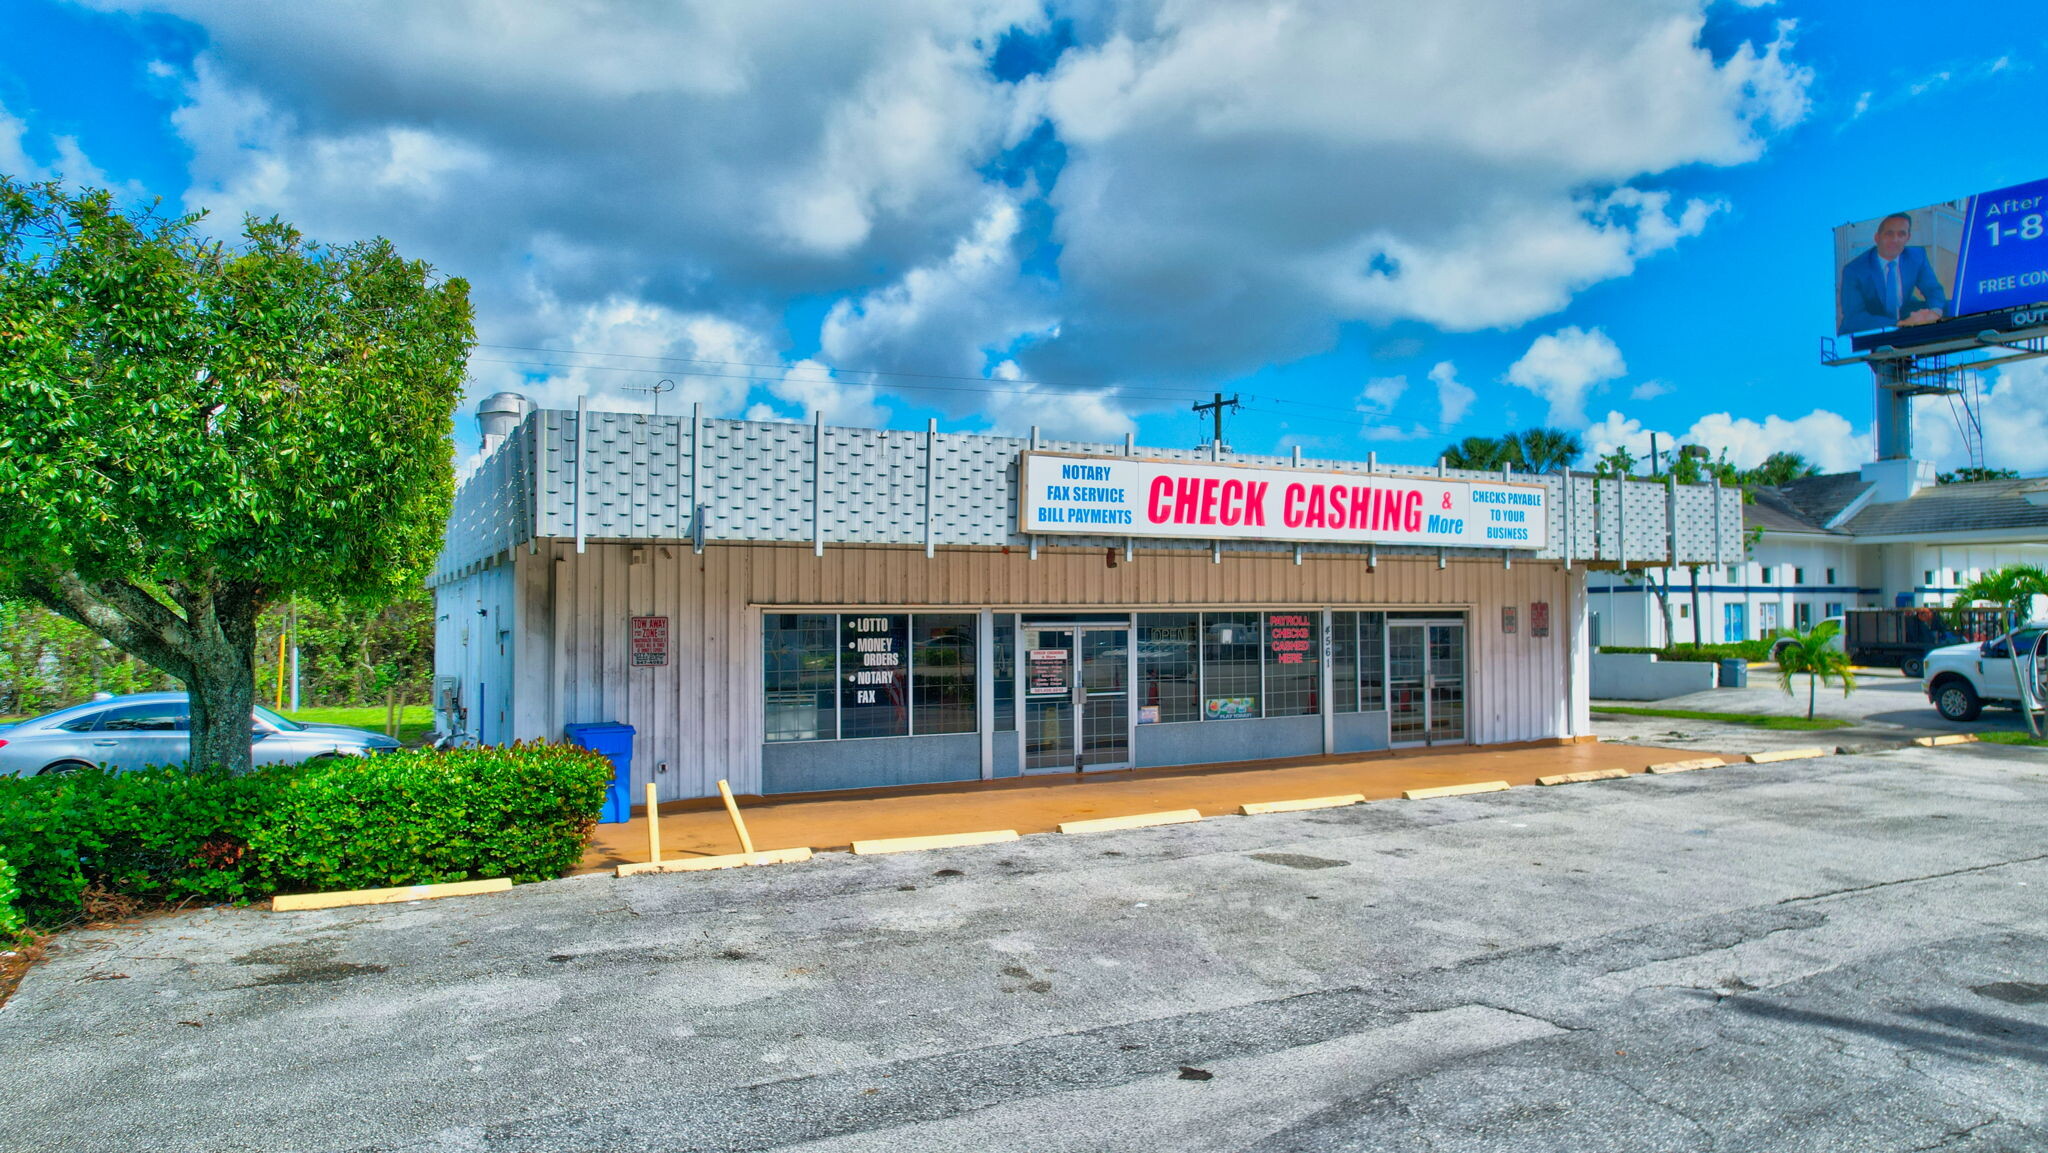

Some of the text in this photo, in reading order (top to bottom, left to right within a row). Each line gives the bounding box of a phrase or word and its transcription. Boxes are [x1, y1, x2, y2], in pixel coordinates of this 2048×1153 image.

[1986, 196, 2042, 218] After
[1979, 275, 2016, 294] FREE
[1062, 465, 1111, 481] NOTARY
[1047, 485, 1125, 503] FAX SERVICE
[1441, 491, 1453, 510] &
[1472, 490, 1541, 506] CHECKS PAYABLE
[1147, 475, 1423, 533] CHECK CASHING
[1038, 507, 1132, 525] BILL PAYMENTS
[1490, 509, 1525, 522] TO YOUR
[1427, 514, 1463, 535] More
[1487, 527, 1528, 540] BUSINESS
[634, 619, 666, 629] TOW AWAY
[857, 618, 888, 632] LOTTO
[1269, 615, 1311, 626] PAYROLL
[642, 628, 658, 638] ZONE
[1153, 628, 1185, 642] OPEN
[1272, 628, 1309, 639] CHECKS
[857, 638, 893, 652] MONEY
[1272, 640, 1309, 651] CASHED
[863, 653, 899, 666] ORDERS
[1278, 653, 1303, 664] HERE
[857, 671, 894, 685] NOTARY
[857, 690, 876, 704] FAX
